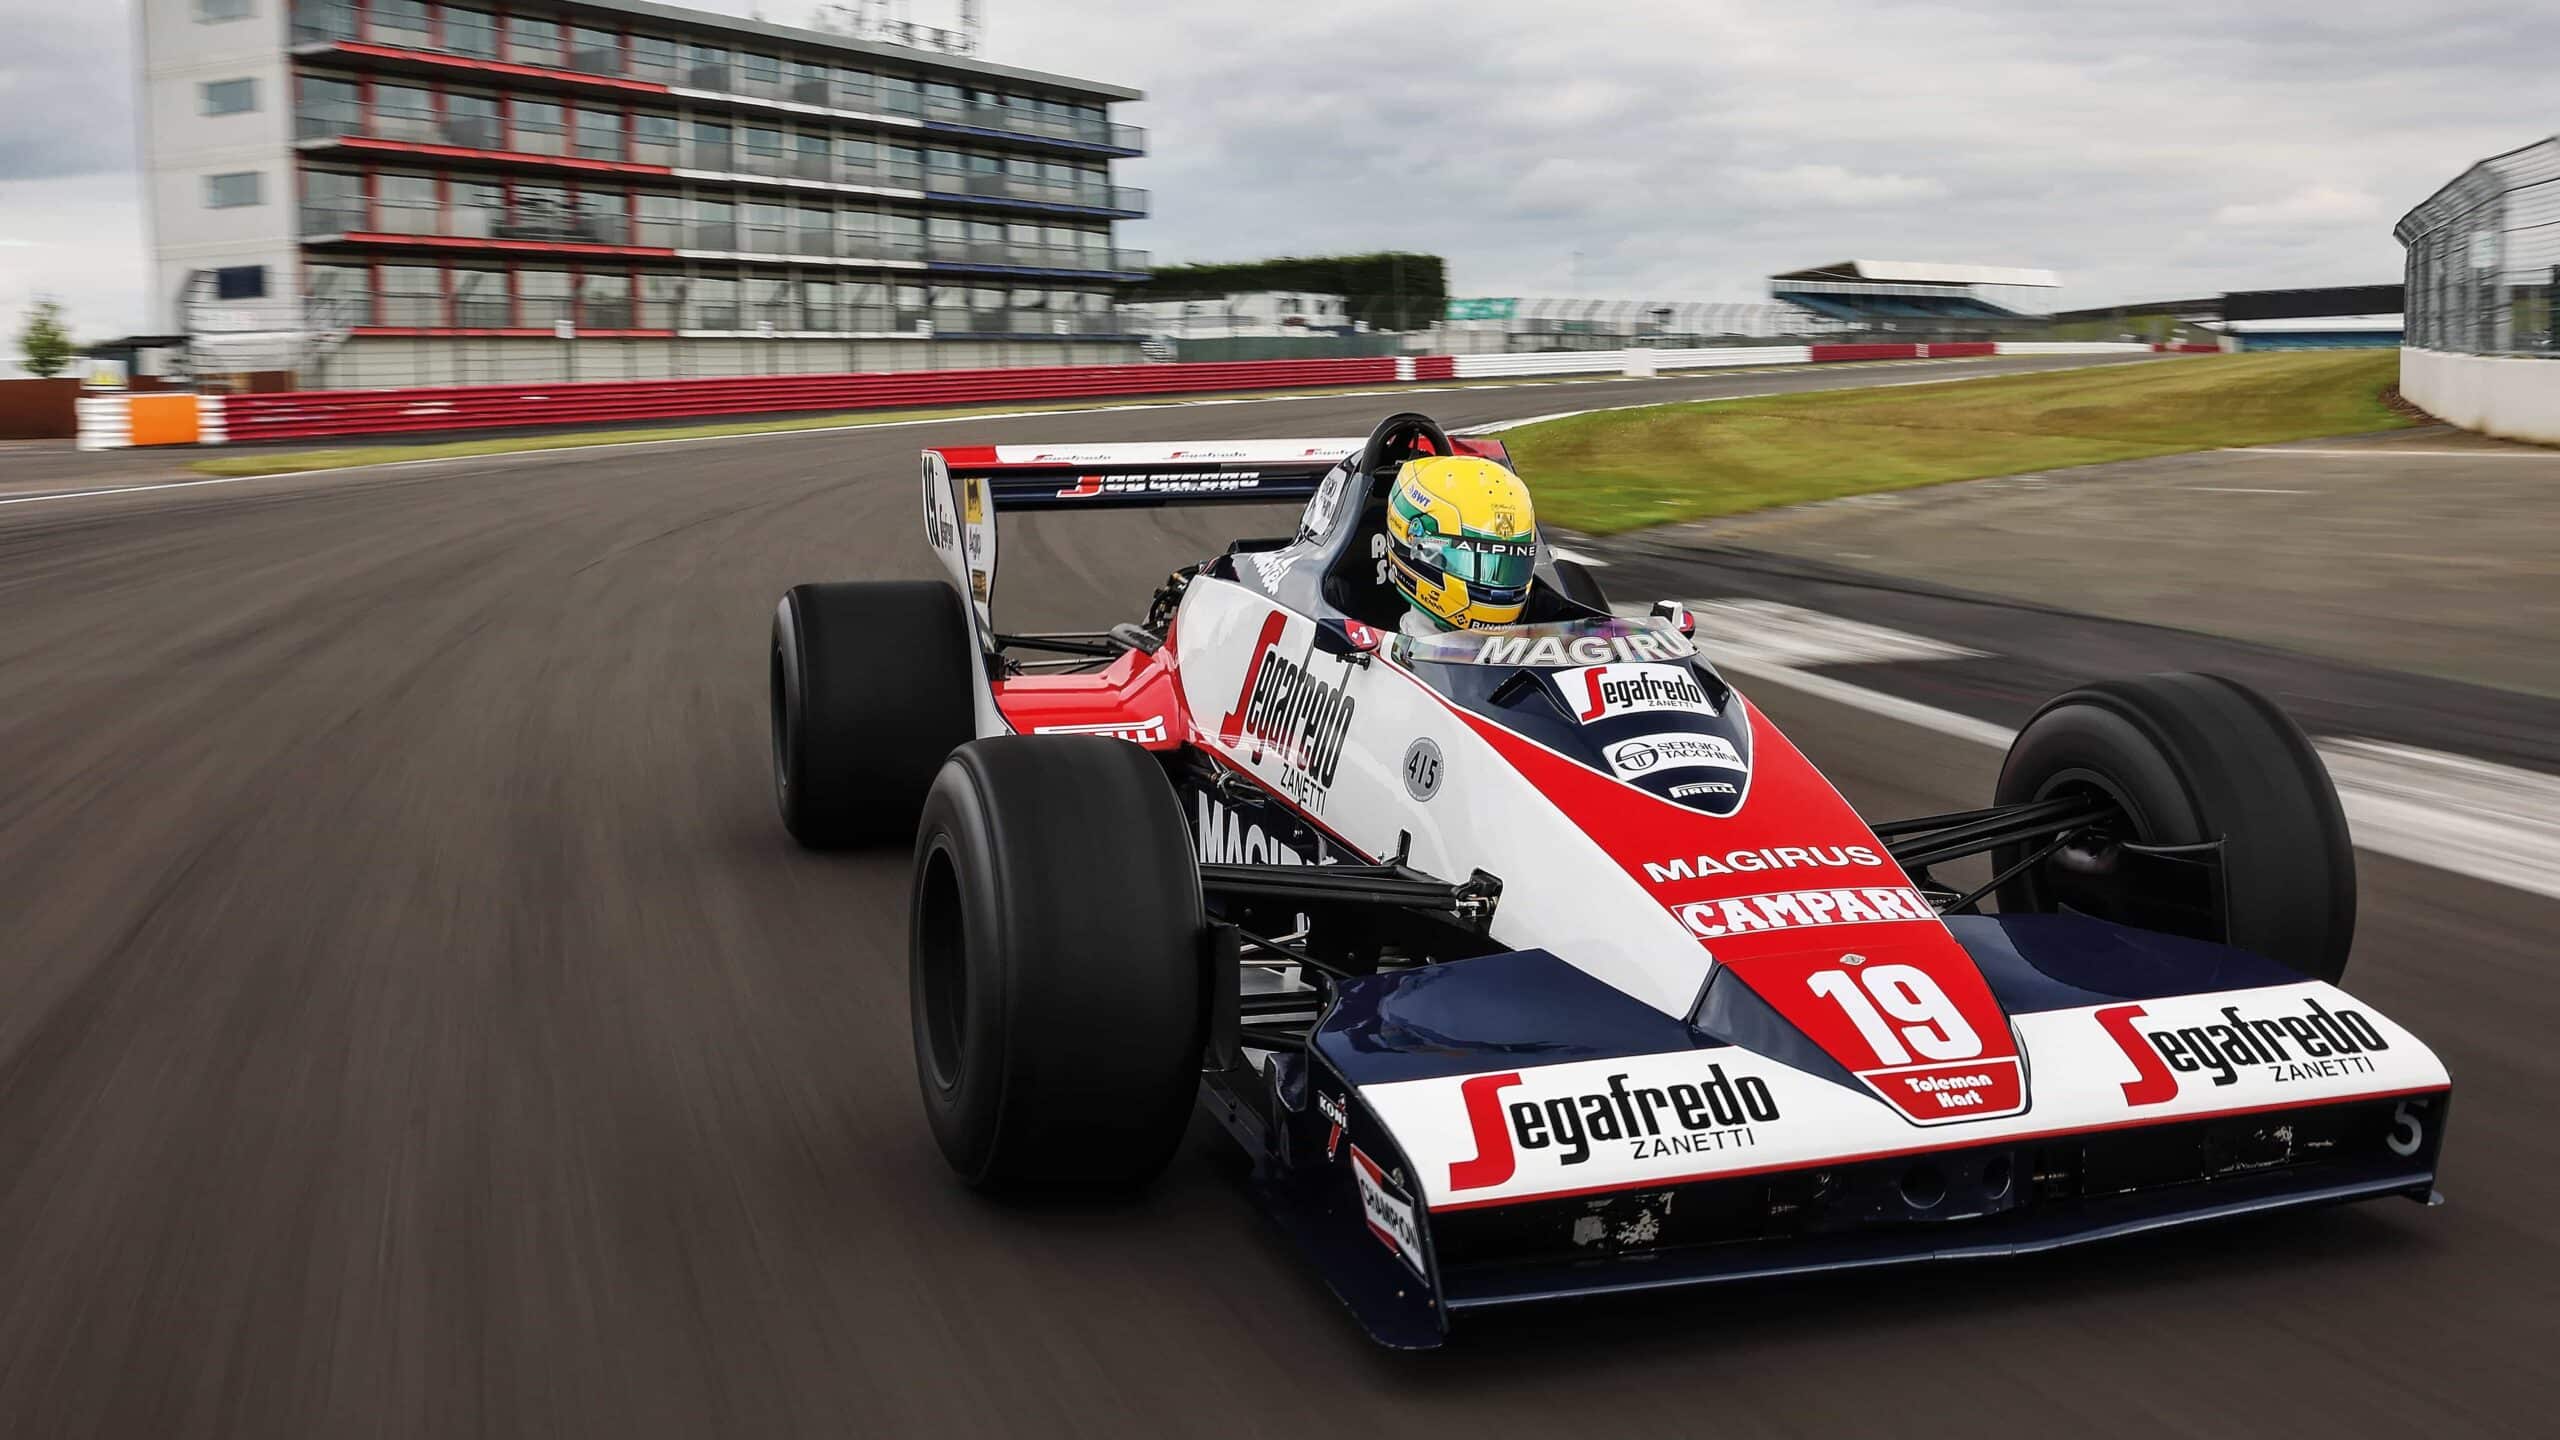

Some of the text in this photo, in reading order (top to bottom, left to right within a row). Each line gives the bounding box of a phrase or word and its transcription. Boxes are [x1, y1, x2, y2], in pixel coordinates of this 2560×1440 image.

[1411, 489, 1431, 507] BWT
[1455, 541, 1536, 557] ALPINE
[1472, 630, 1692, 665] MAGIRU
[1581, 667, 1702, 722] Segafredo
[1648, 699, 1694, 709] ZANETTI
[1657, 741, 1721, 752] SERGIO
[1660, 750, 1739, 764] TACCHINI
[1408, 751, 1438, 789] 415
[1280, 763, 1327, 816] ZANETTI
[1668, 782, 1737, 798] PIRELLI
[1641, 845, 1884, 883] MAGIRUS
[1680, 889, 1936, 936] CAMPARI
[1806, 963, 1983, 1066] 19
[2094, 998, 2390, 1107] Segafredo
[2268, 1055, 2376, 1083] ZANETTI
[1904, 1073, 1994, 1093] Toleman
[1935, 1089, 1984, 1108] Hart
[1448, 1063, 1781, 1192] Segafredo
[1630, 1127, 1756, 1160] ZANETTI
[2386, 1099, 2428, 1157] 5
